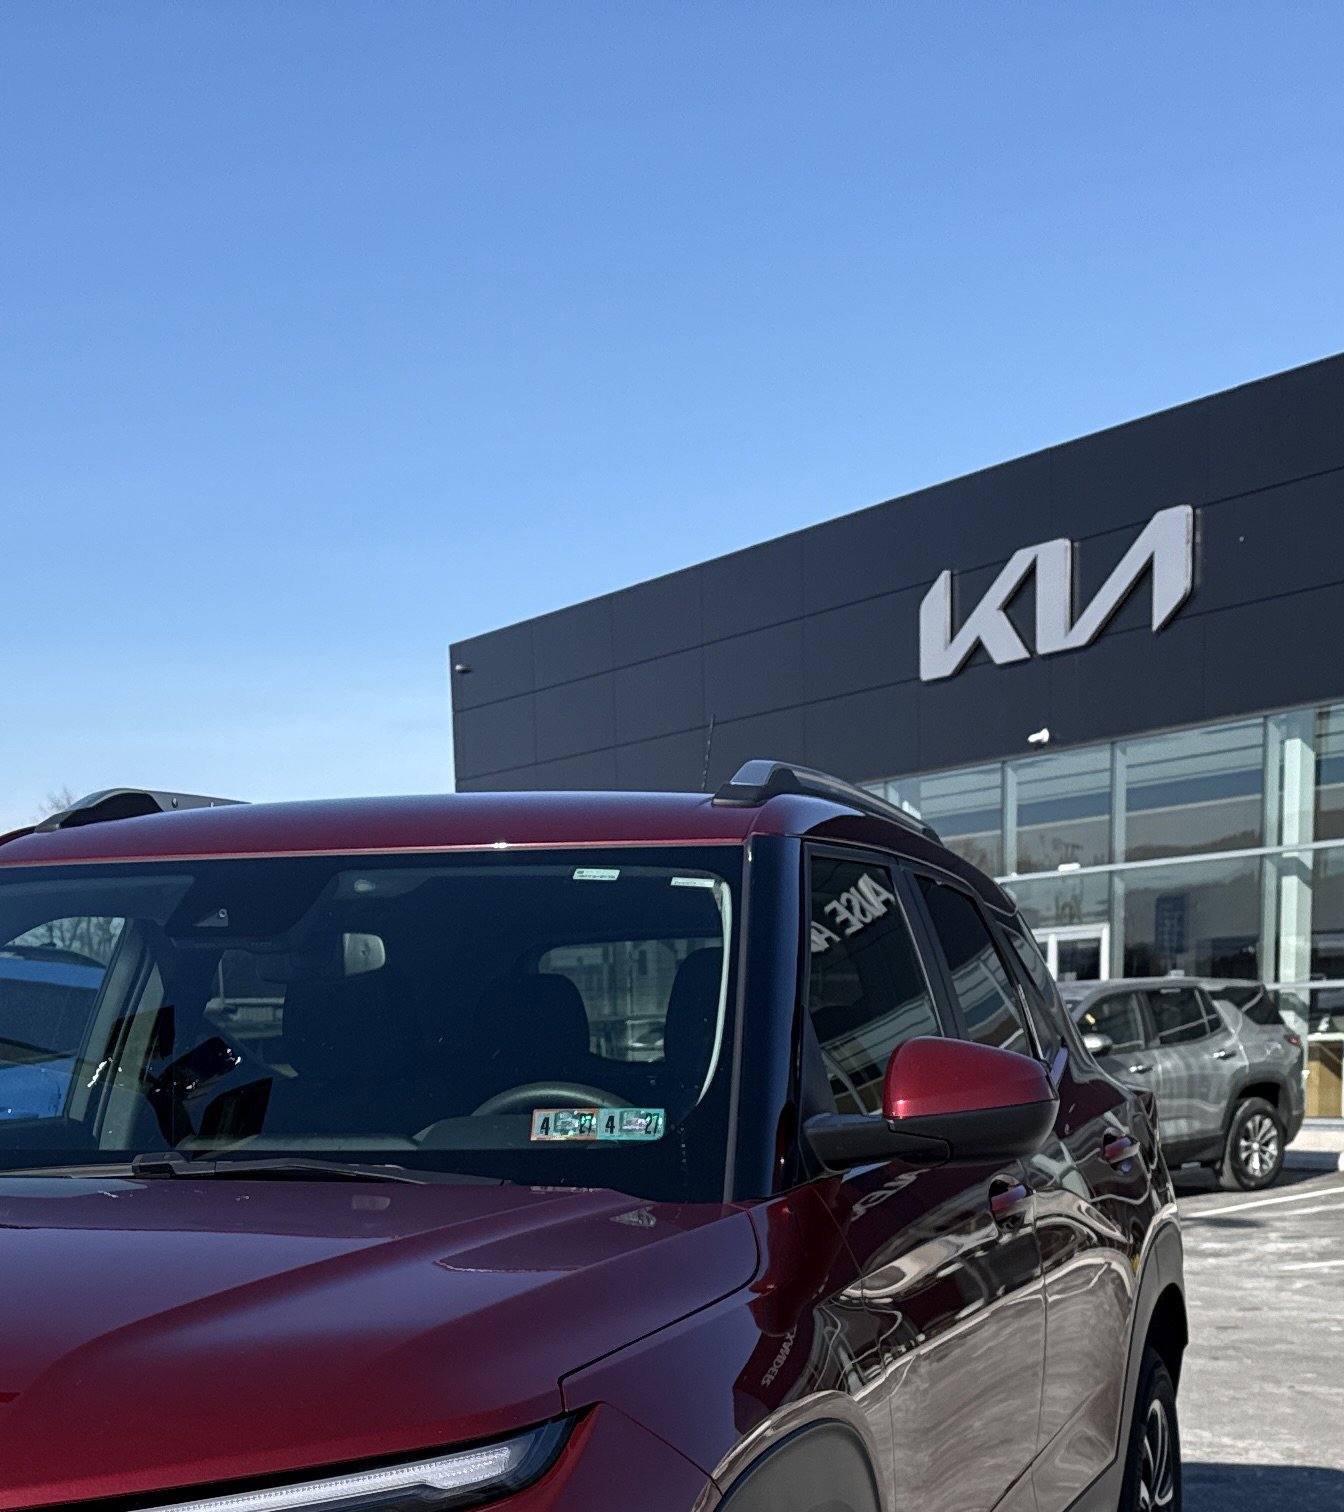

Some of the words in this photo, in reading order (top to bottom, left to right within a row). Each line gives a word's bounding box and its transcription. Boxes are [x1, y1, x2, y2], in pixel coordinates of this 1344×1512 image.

[919, 504, 1195, 682] KIA
[540, 1116, 551, 1136] 4
[578, 1112, 594, 1135] 27
[604, 1115, 616, 1135] 4
[644, 1112, 660, 1136] 27
